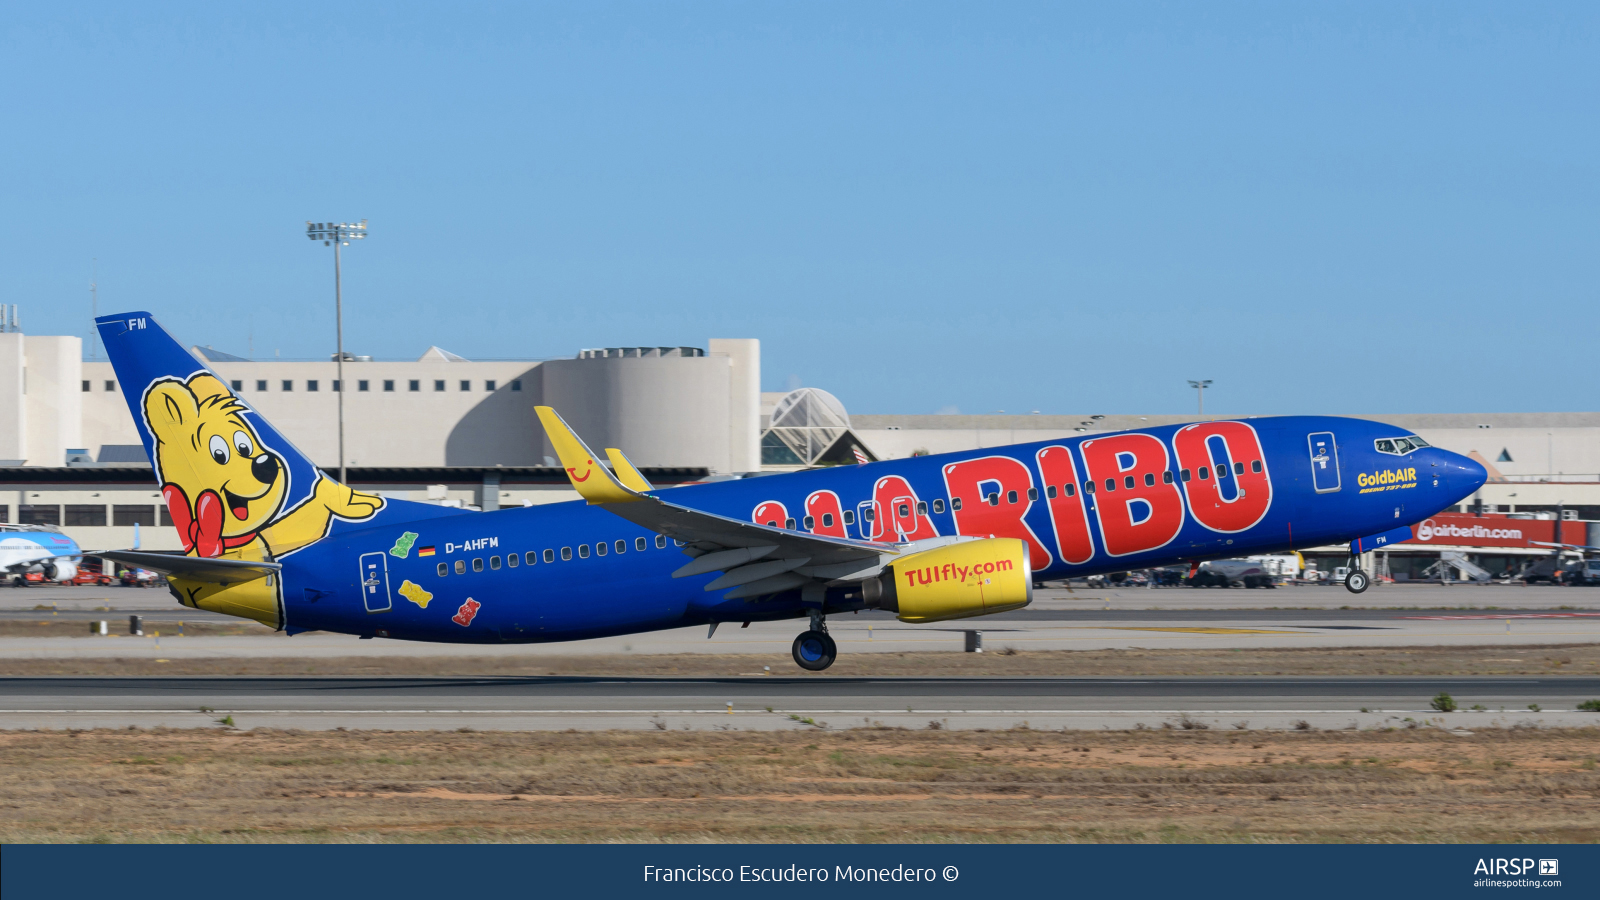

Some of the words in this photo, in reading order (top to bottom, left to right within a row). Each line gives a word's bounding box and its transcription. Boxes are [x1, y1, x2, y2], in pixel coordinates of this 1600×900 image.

[128, 318, 147, 331] FM
[1357, 467, 1417, 487] GoldbAIR
[1386, 482, 1418, 491] 737-800
[1376, 535, 1387, 545] FM
[1432, 523, 1522, 540] airberlin.com
[445, 536, 499, 554] D-AHFM
[905, 559, 1014, 587] TUIfly.com
